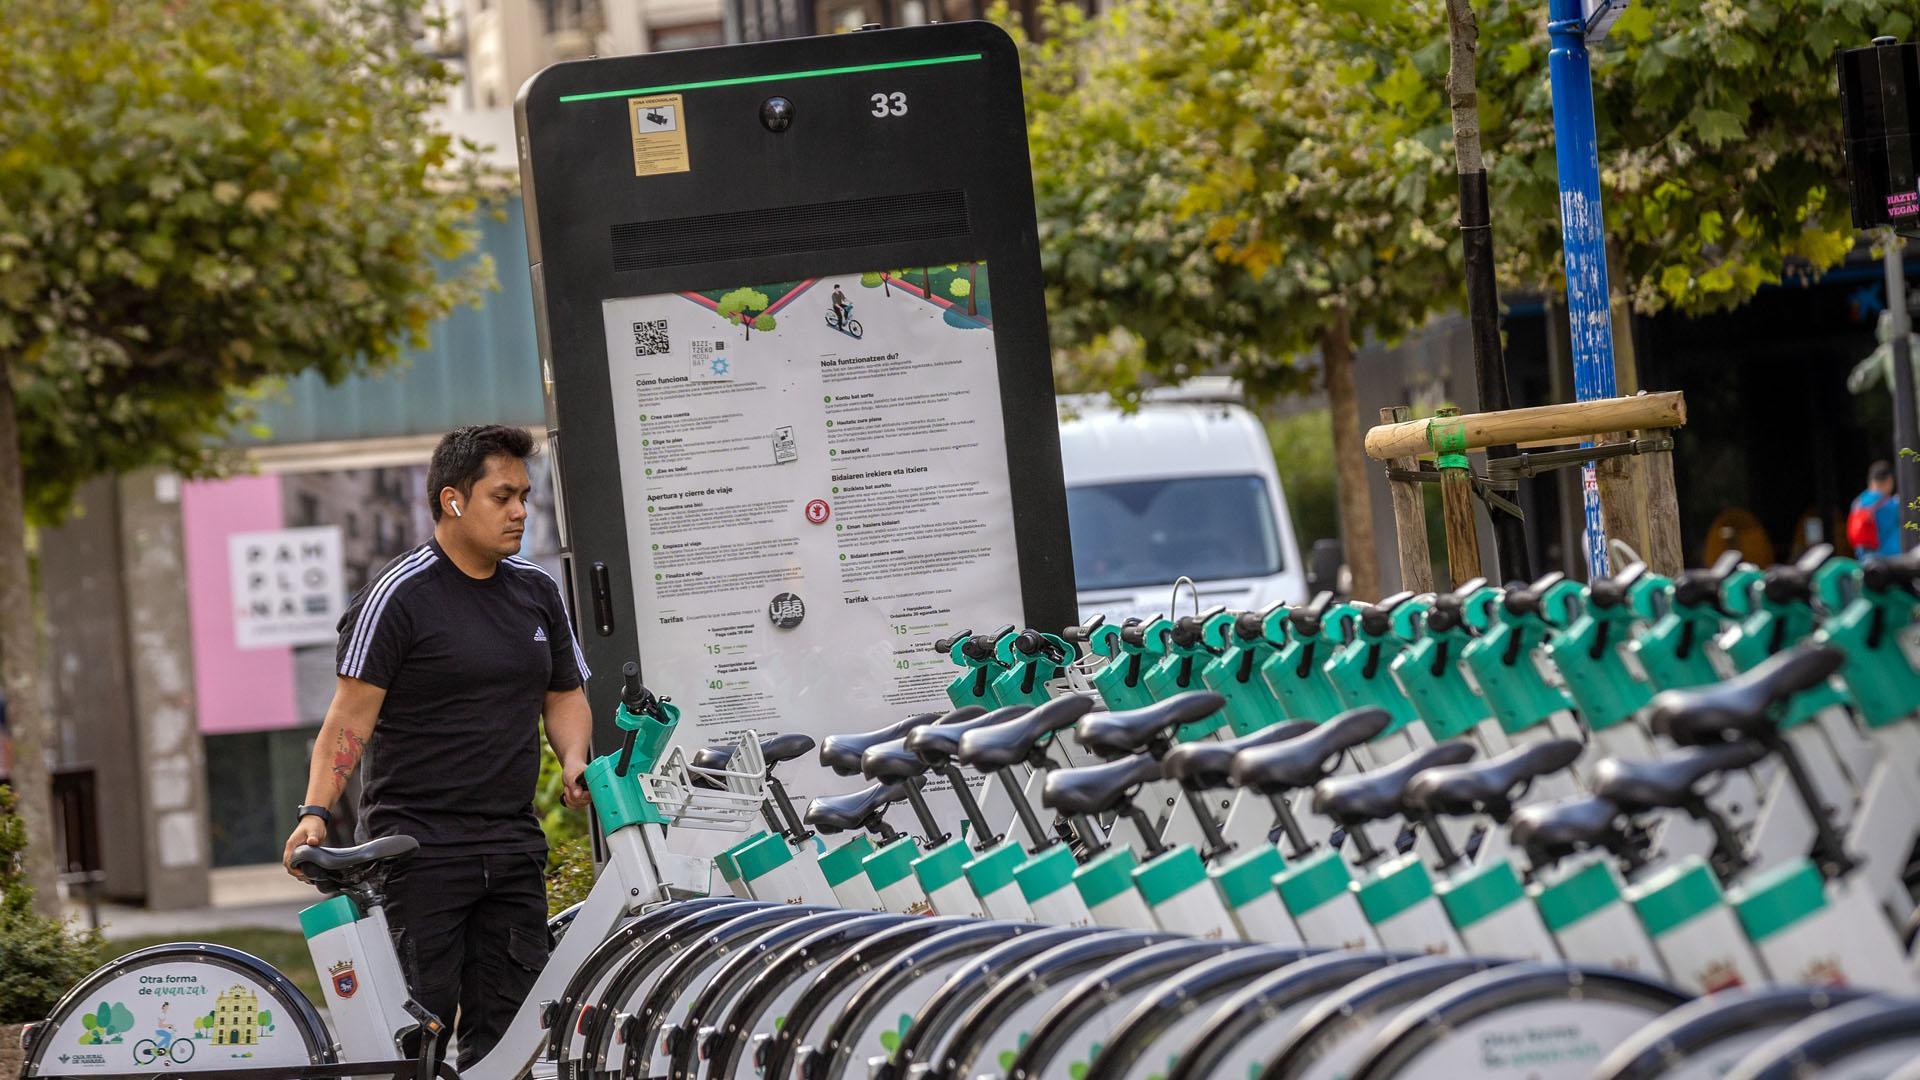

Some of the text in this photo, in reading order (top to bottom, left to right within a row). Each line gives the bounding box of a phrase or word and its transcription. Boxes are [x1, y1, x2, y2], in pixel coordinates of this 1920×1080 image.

[870, 92, 908, 118] 33
[1887, 192, 1918, 204] HAZTE
[1888, 204, 1920, 216] VEGAN
[821, 359, 837, 368] Nola
[837, 355, 889, 367] funtzionatzen
[636, 375, 689, 387] Cómo funciona
[831, 474, 864, 482] Bidaiaren
[865, 470, 892, 479] irekiera
[905, 466, 928, 474] itxiera
[647, 492, 678, 502] Apertura
[684, 489, 705, 497] cierre
[715, 486, 733, 495] viaje
[844, 595, 869, 604] Tarifak
[659, 616, 684, 624] Tarifas
[894, 624, 907, 635] 15
[707, 644, 721, 655] 15
[896, 659, 910, 670] 40
[709, 680, 723, 690] 40
[139, 974, 197, 984] Otra forma
[138, 985, 208, 997] de avanzar
